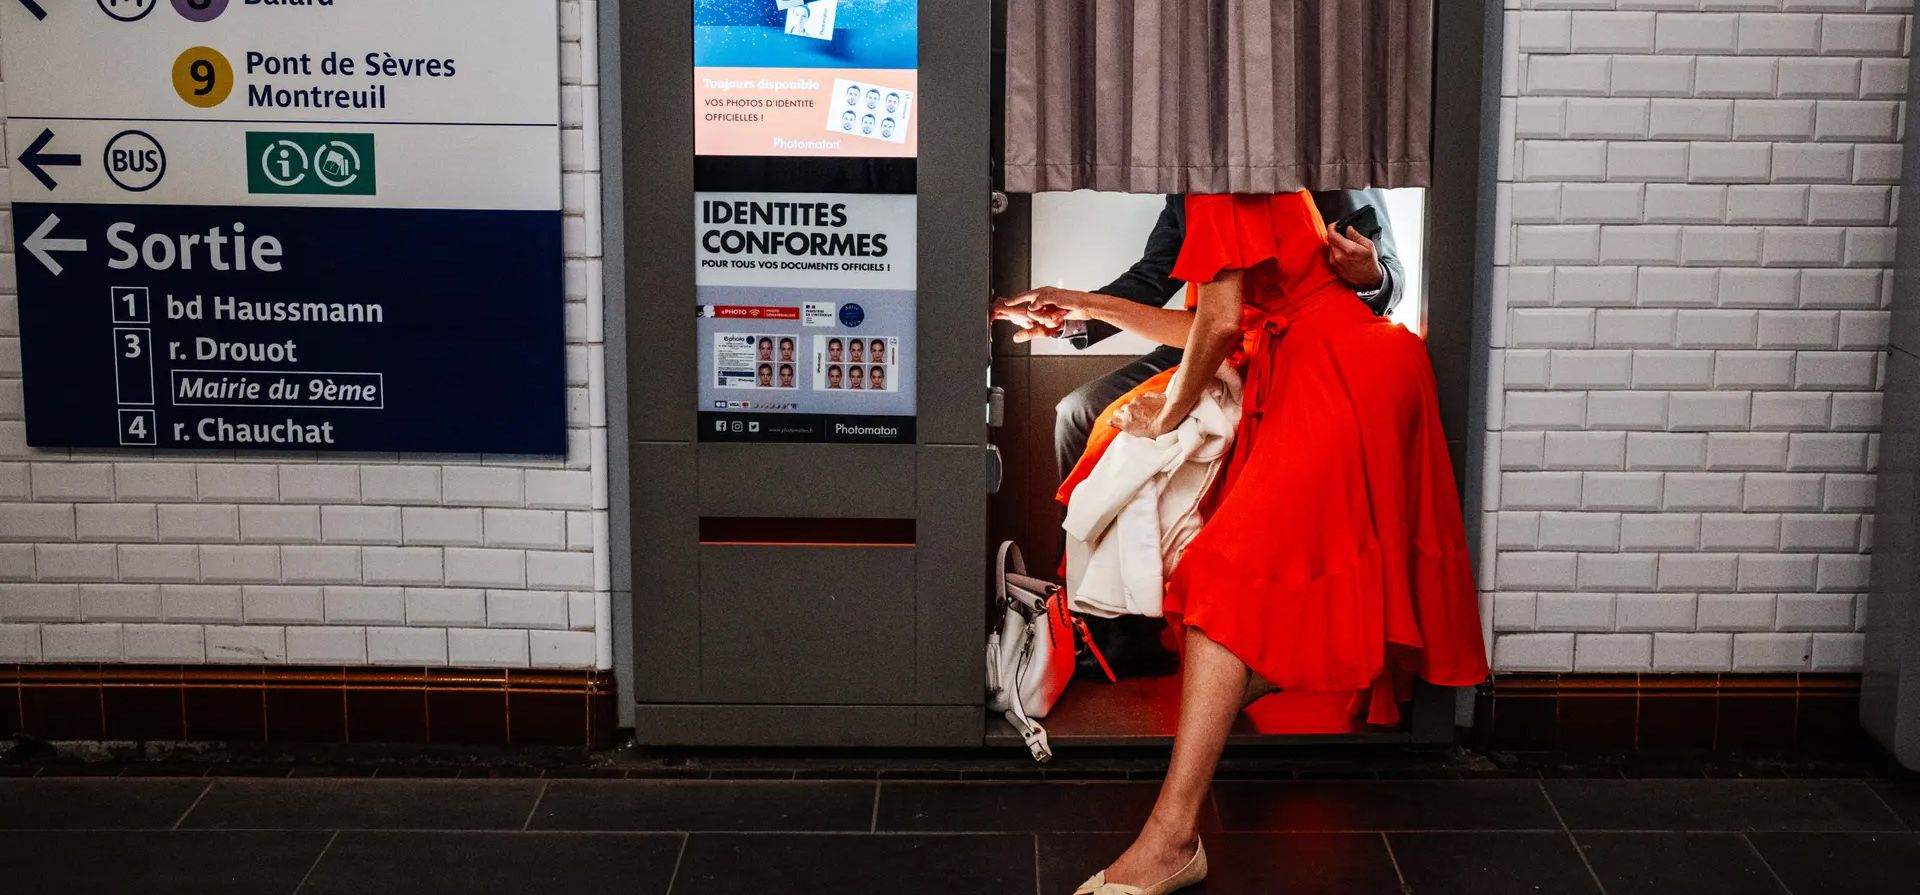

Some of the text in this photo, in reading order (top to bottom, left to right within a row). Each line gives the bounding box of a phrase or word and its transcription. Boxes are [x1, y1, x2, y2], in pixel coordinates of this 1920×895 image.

[247, 52, 456, 77] Pont de Sèvres
[189, 60, 215, 96] 9
[704, 79, 820, 92] Toujours disponible
[247, 84, 386, 109] Montreuil
[705, 99, 724, 107] VOS
[726, 99, 763, 108] PHOTOS
[705, 113, 758, 122] OFFICIELLES
[773, 137, 839, 149] Photomaton
[112, 149, 157, 173] BUS
[107, 222, 284, 273] Sortie
[702, 229, 888, 257] CONFORMES
[702, 260, 728, 268] POUR
[731, 260, 756, 269] TOUS
[758, 261, 778, 270] VOS
[780, 262, 839, 271] DOCUMENTS
[841, 263, 885, 272] OFFICIELS
[122, 294, 136, 317] 1
[167, 296, 384, 323] bd Haussmann
[125, 335, 141, 360] 3
[169, 338, 297, 362] r. Drouot
[179, 378, 377, 402] Mairie du 9ème
[128, 416, 147, 438] 4
[173, 418, 334, 444] r. Chauchat
[835, 423, 898, 436] Photomaton
